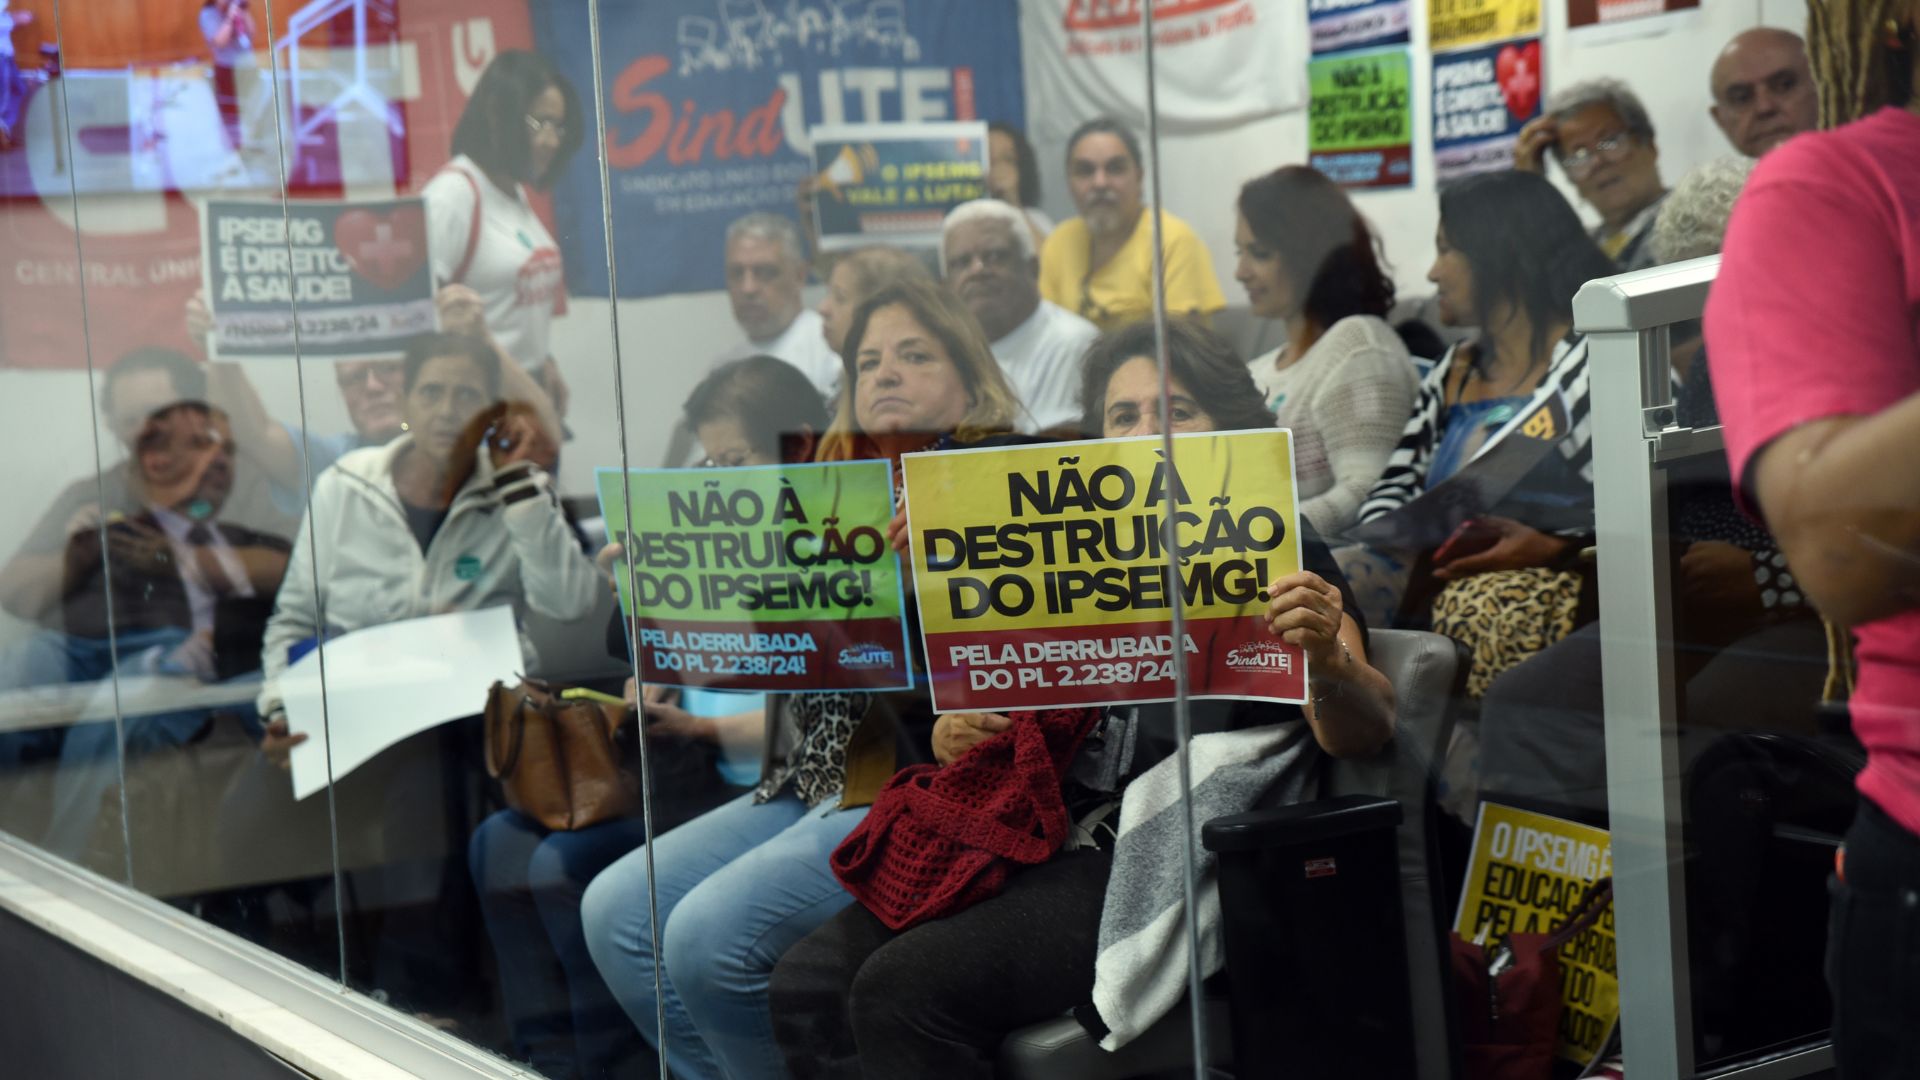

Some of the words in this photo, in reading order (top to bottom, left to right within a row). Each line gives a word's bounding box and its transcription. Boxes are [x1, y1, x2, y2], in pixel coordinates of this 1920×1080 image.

[218, 216, 325, 244] IPSEMG
[667, 480, 764, 528] NÃO
[772, 477, 809, 526] À
[1008, 456, 1136, 517] NÃO
[1144, 449, 1192, 508] À
[615, 517, 885, 575] DESTRUIÇÃO
[923, 496, 1286, 573] DESTRUIÇÃO
[635, 572, 693, 610] DO
[698, 569, 874, 611] IPSEMG!
[948, 573, 1035, 620] DO
[1045, 558, 1272, 615] IPSEMG!
[640, 628, 687, 652] PELA
[688, 630, 818, 654] DERRUBADA
[653, 651, 682, 672] DO
[686, 651, 710, 674] PL
[710, 651, 807, 676] 2.238/24!
[949, 641, 1023, 666] PELA
[1024, 633, 1200, 665] DERRUBADA
[969, 669, 1013, 692] DO
[1019, 666, 1054, 689] PL
[1057, 659, 1178, 688] 2.238/24
[1491, 822, 1513, 859] O
[1512, 826, 1599, 880] IPSEMG
